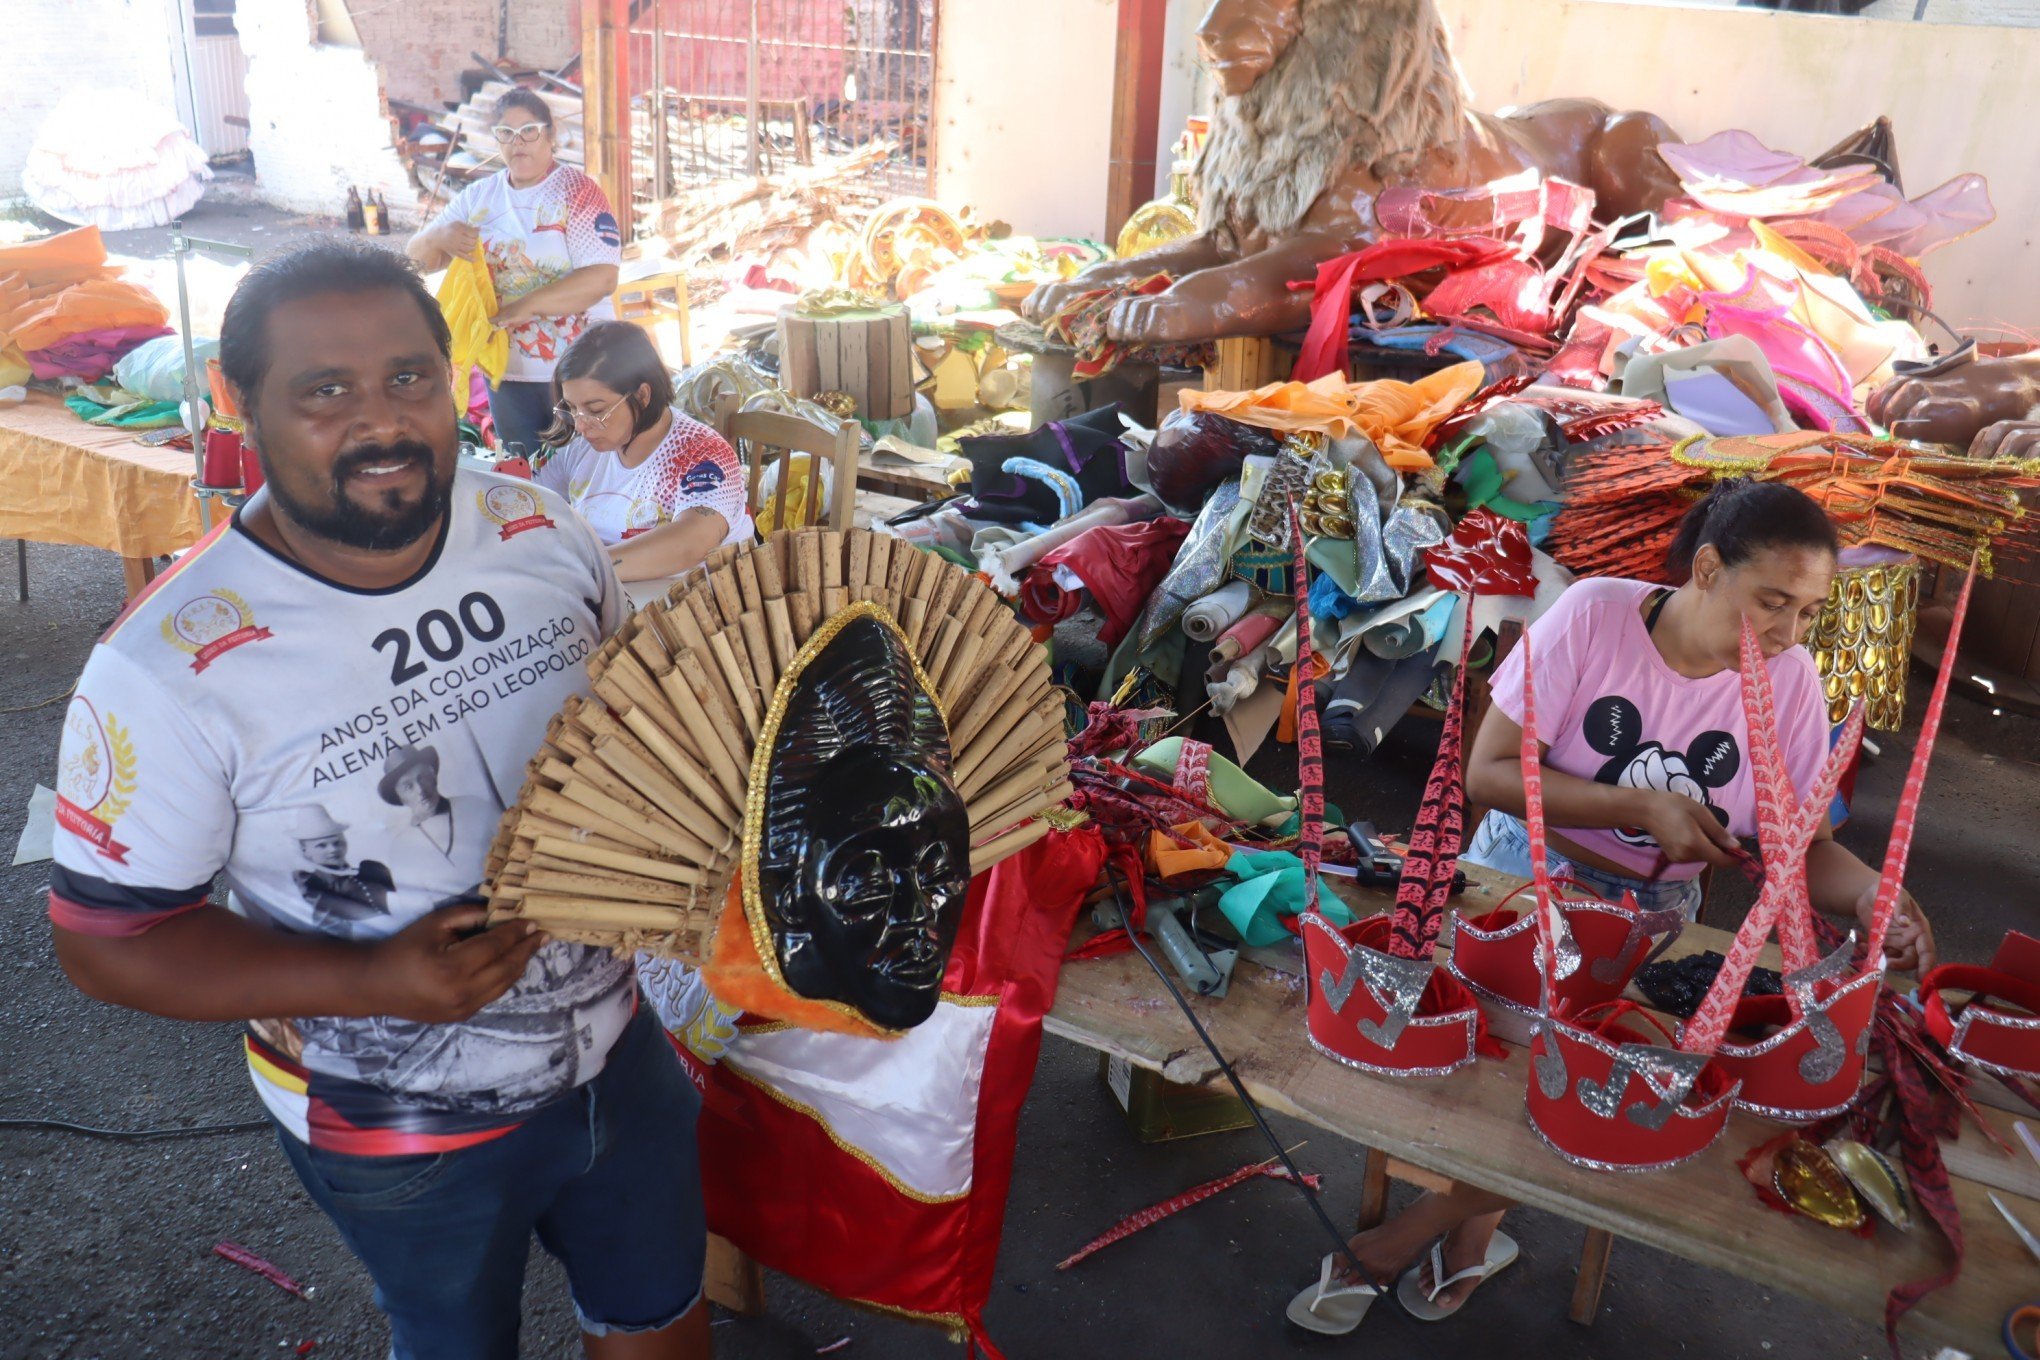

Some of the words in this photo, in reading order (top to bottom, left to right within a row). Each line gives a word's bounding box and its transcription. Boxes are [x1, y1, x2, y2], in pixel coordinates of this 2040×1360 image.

[320, 705, 389, 754] ANOS
[390, 688, 429, 717] DA
[429, 615, 576, 697] COLONIZAÇÃO
[371, 591, 506, 687] 200
[312, 730, 403, 789] ALEMÃ
[402, 713, 442, 746] EM
[442, 689, 490, 725] SÃO
[492, 637, 590, 700] LEOPOLDO
